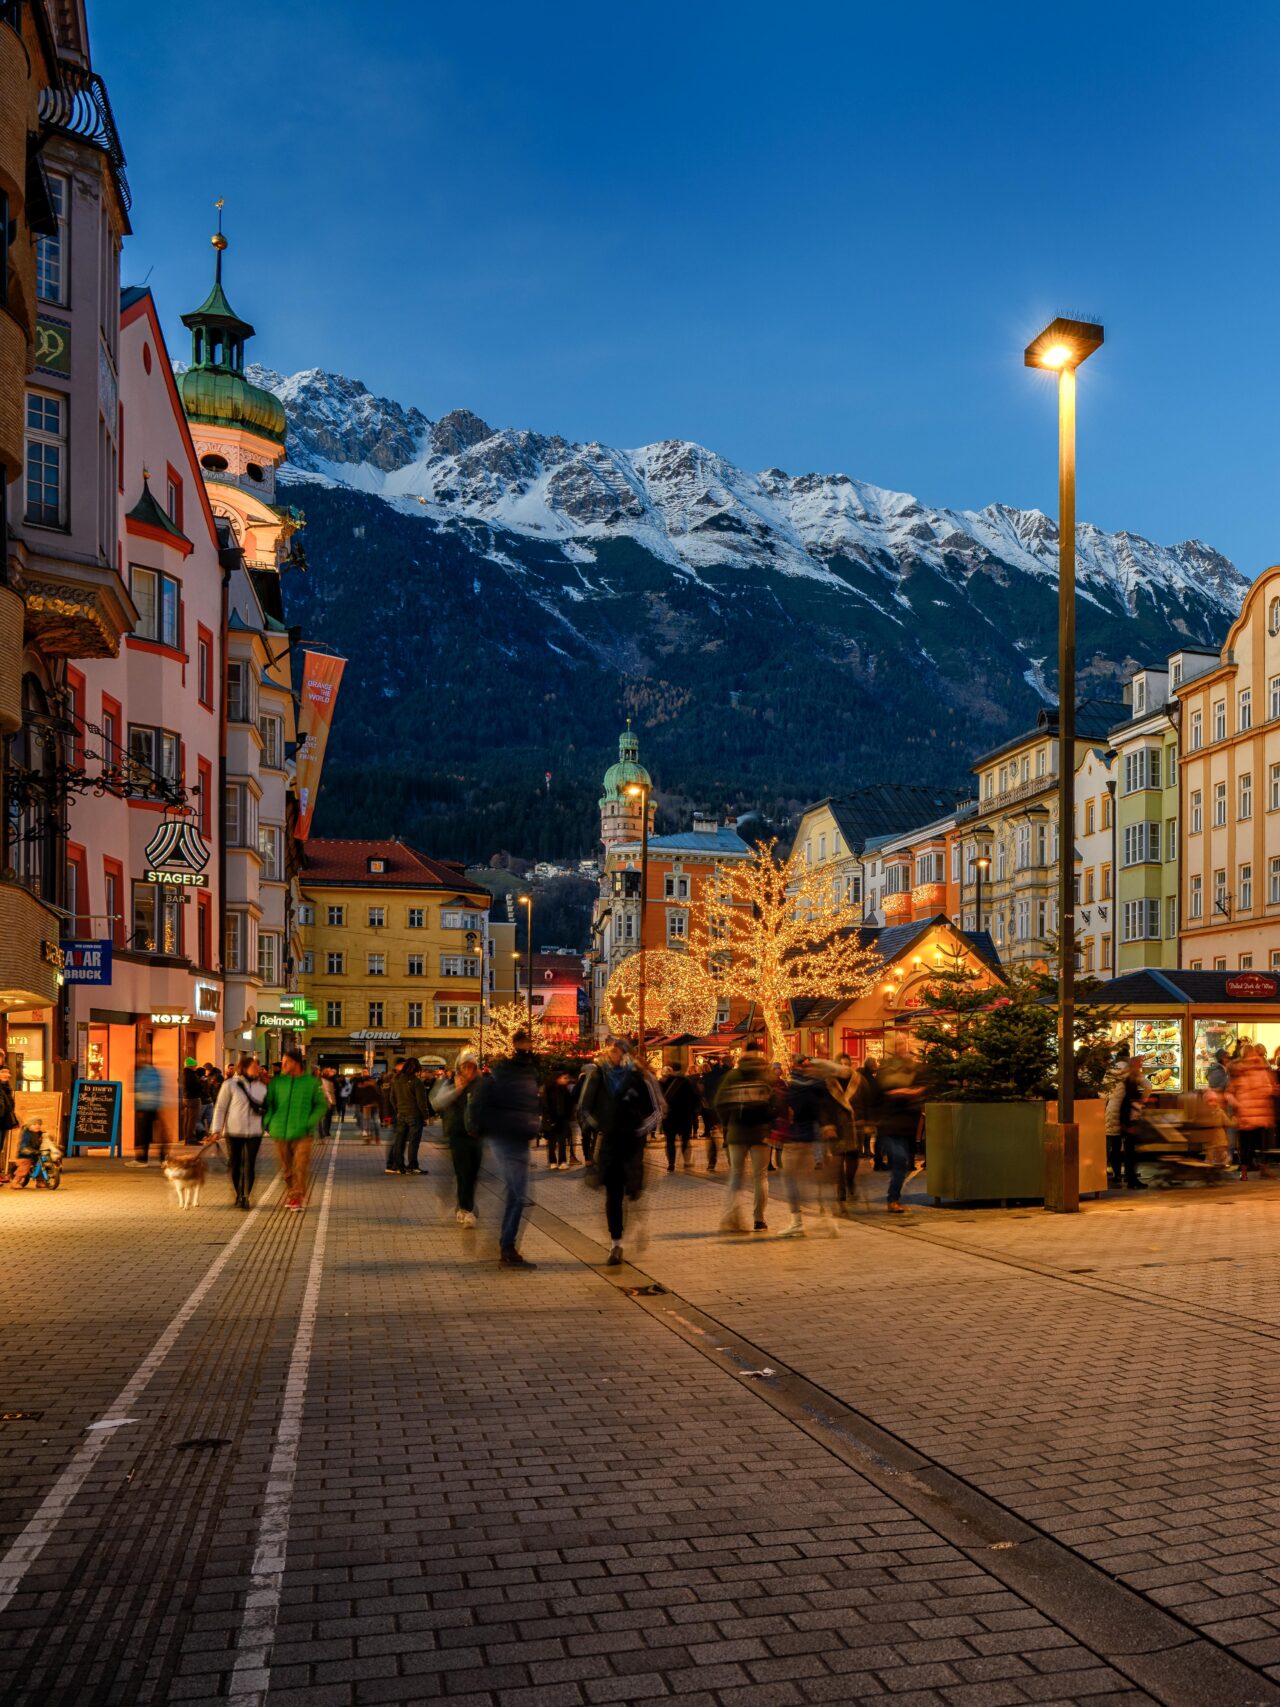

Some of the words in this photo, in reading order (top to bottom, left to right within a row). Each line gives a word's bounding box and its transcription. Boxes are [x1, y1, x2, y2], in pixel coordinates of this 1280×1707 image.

[308, 693, 330, 704] WORLD
[147, 871, 204, 886] STAGE12
[165, 895, 186, 903] BAR
[151, 1014, 190, 1024] NORZ
